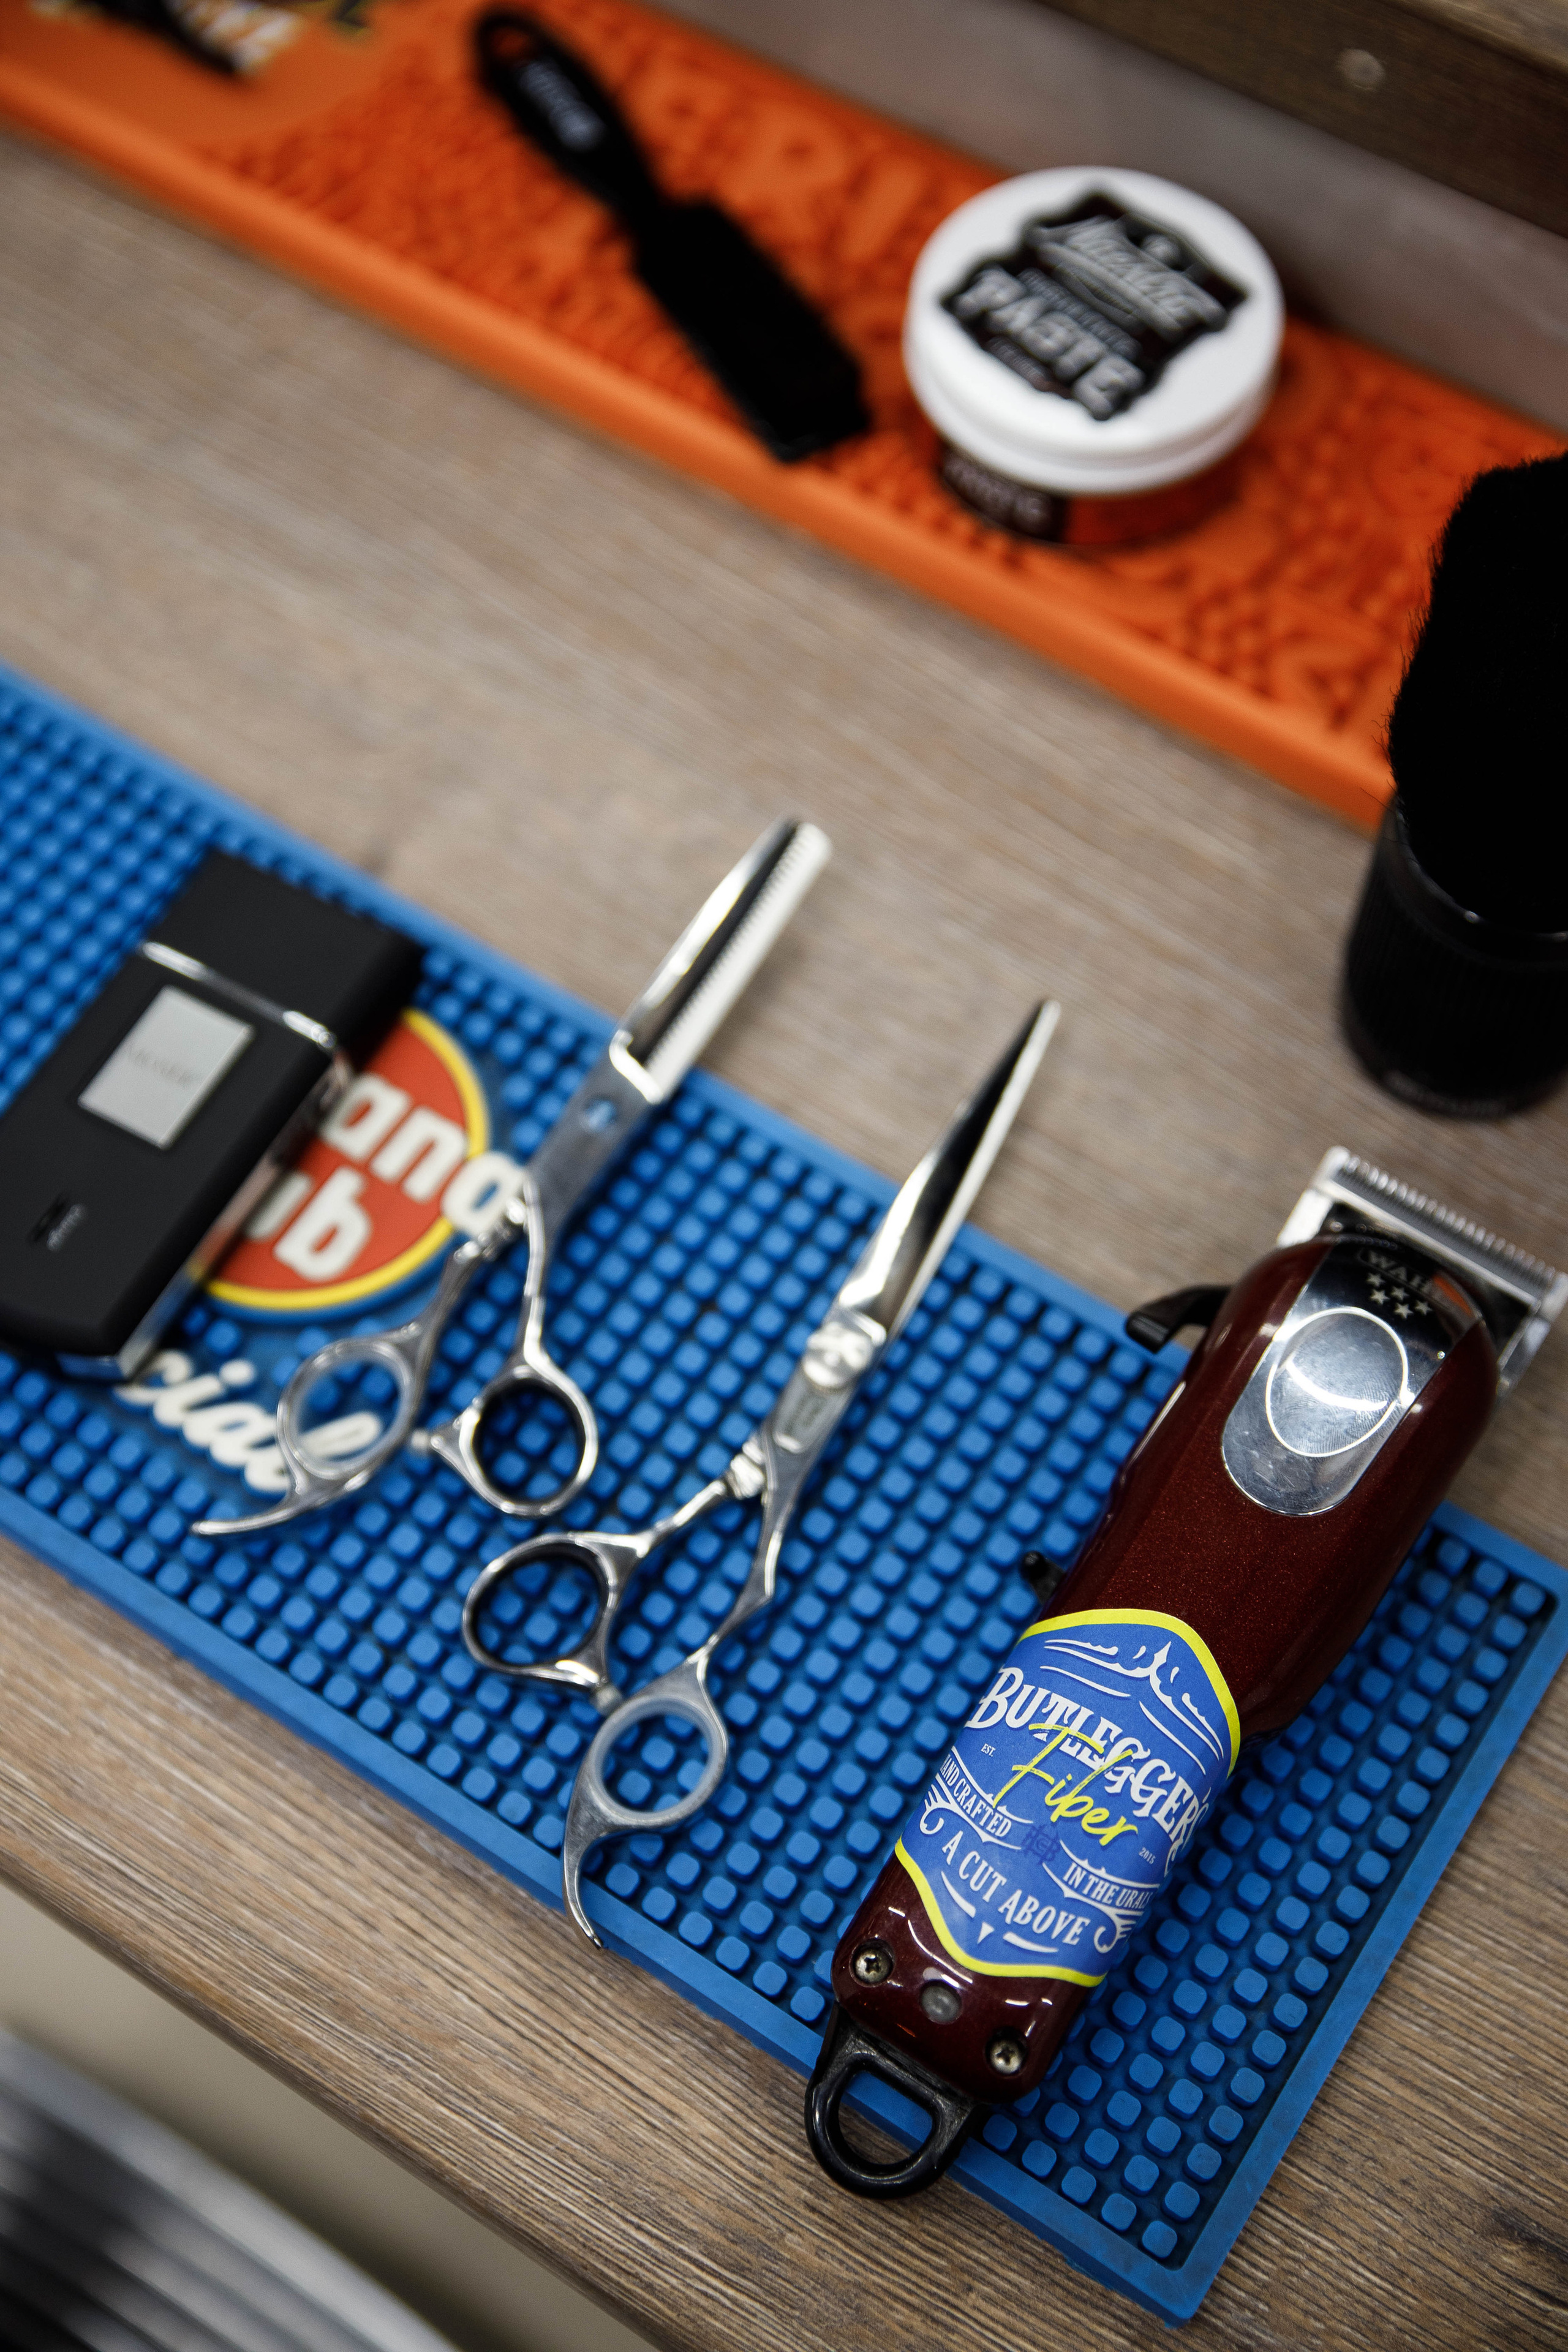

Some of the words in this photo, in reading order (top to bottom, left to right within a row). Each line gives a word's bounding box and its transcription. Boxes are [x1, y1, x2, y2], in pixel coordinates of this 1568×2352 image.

[951, 263, 1145, 421] PASTE
[981, 1743, 996, 1757] EST.
[954, 1778, 1012, 1837] CRAFTED
[992, 1722, 1138, 1846] Fiber
[1063, 1861, 1087, 1889] IN
[1082, 1874, 1120, 1904] THE
[1139, 1847, 1156, 1865] 2015
[942, 1830, 963, 1865] A
[959, 1851, 1008, 1902] CUT
[998, 1889, 1091, 1945] ABOVE
